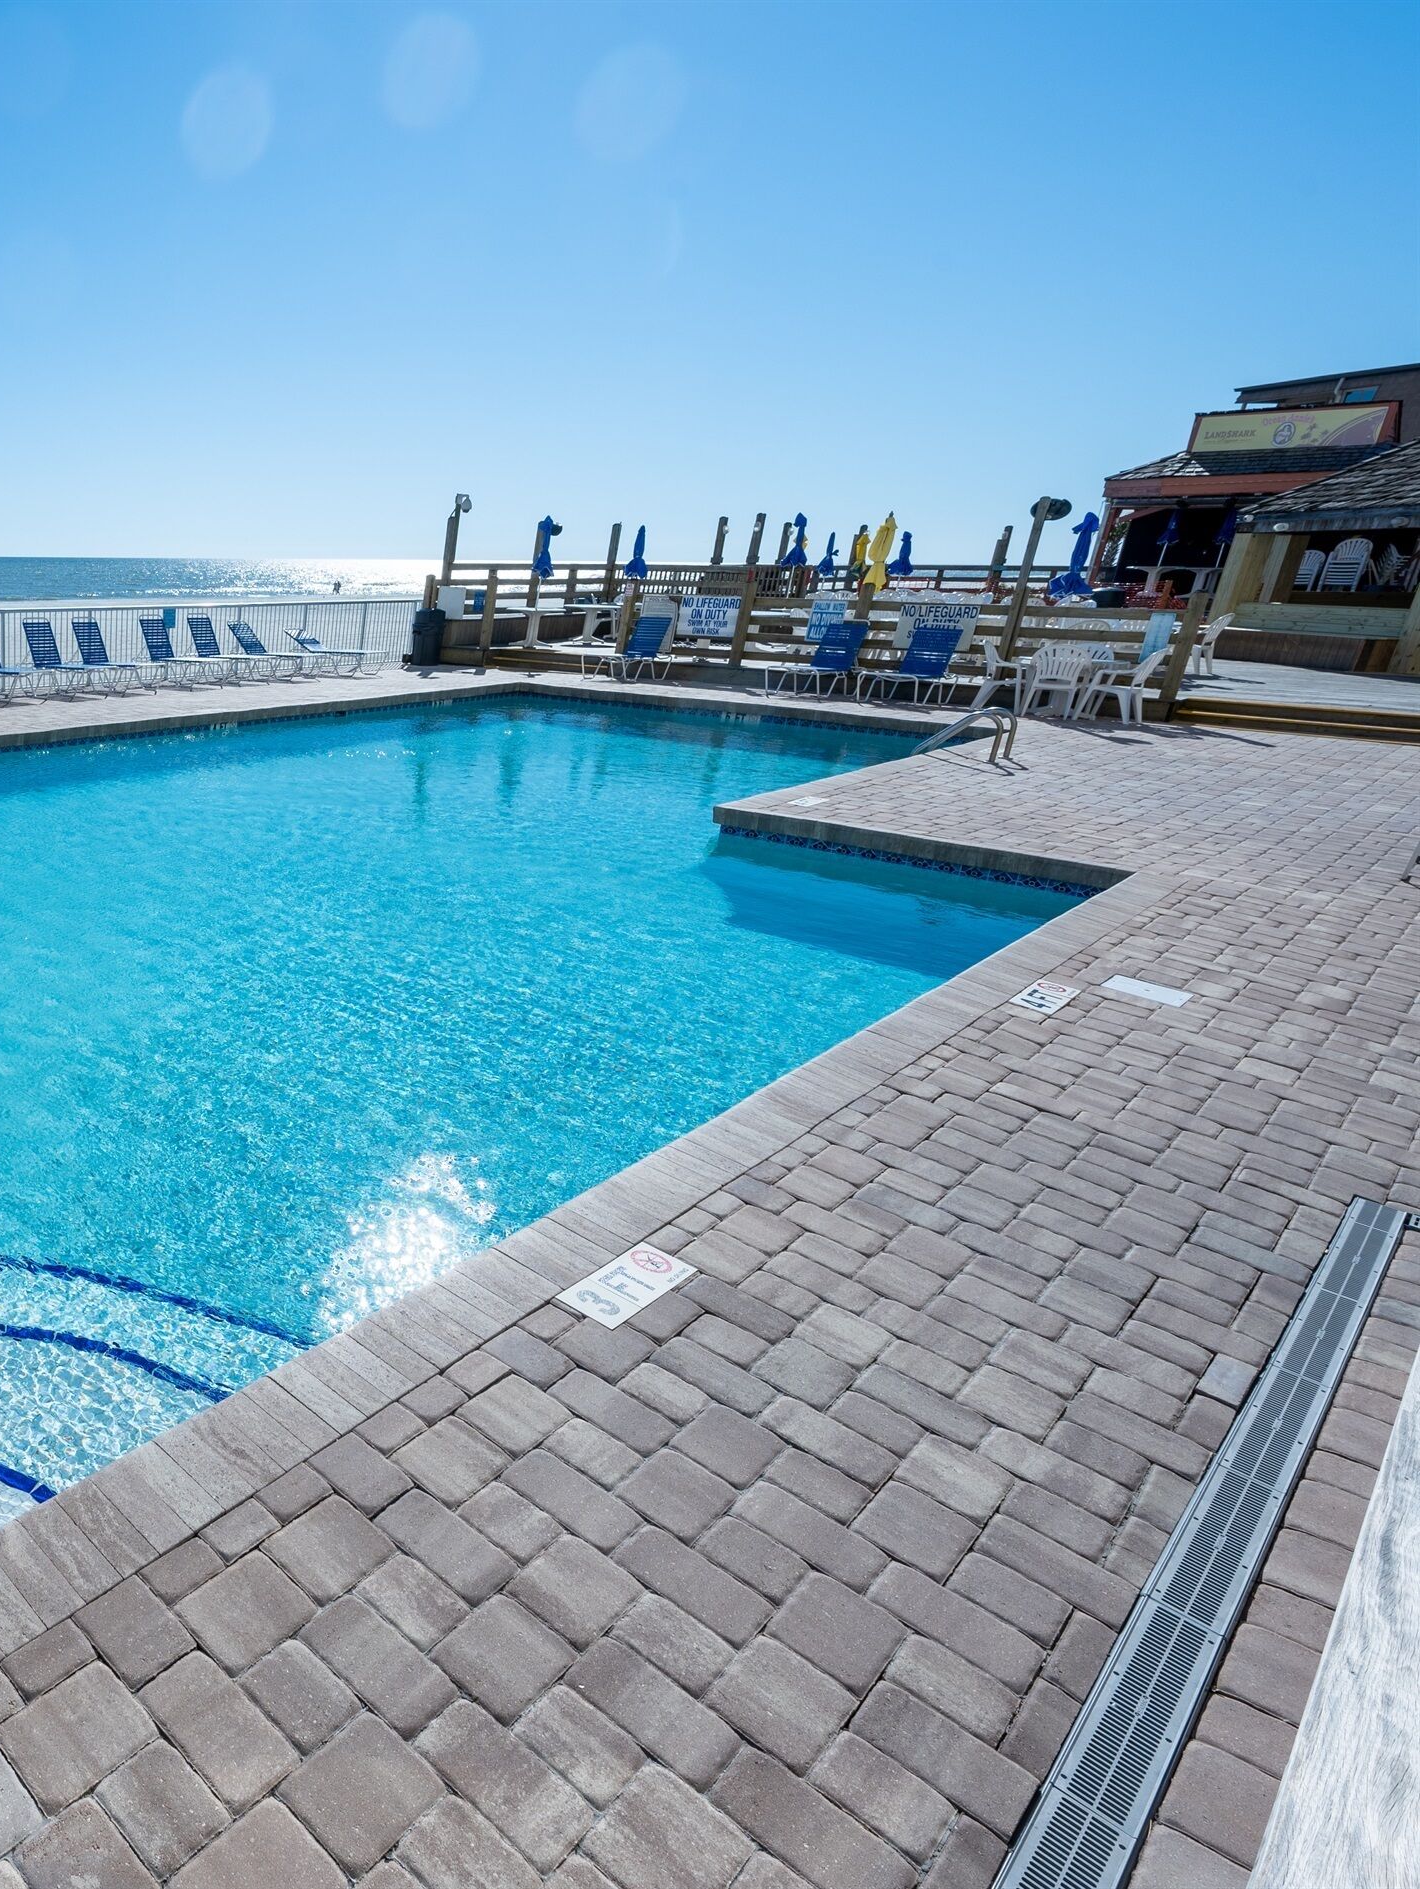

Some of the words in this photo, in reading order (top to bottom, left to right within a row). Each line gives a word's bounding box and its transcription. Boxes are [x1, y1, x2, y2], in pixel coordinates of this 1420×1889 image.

[682, 597, 694, 607] NO
[696, 597, 741, 609] LIFEGUARD
[691, 609, 703, 619] ON
[705, 609, 727, 620] DUTY
[902, 605, 916, 617] NO
[919, 606, 978, 618] LIFEGUARD
[687, 619, 703, 627] SWIM
[704, 619, 712, 627] AT
[713, 620, 728, 628] YOUR
[691, 627, 705, 635] OWN
[707, 627, 720, 636] RISK
[1027, 989, 1063, 1004] FT
[1021, 998, 1051, 1008] 4
[576, 1289, 620, 1316] 3
[598, 1265, 656, 1302] FT
